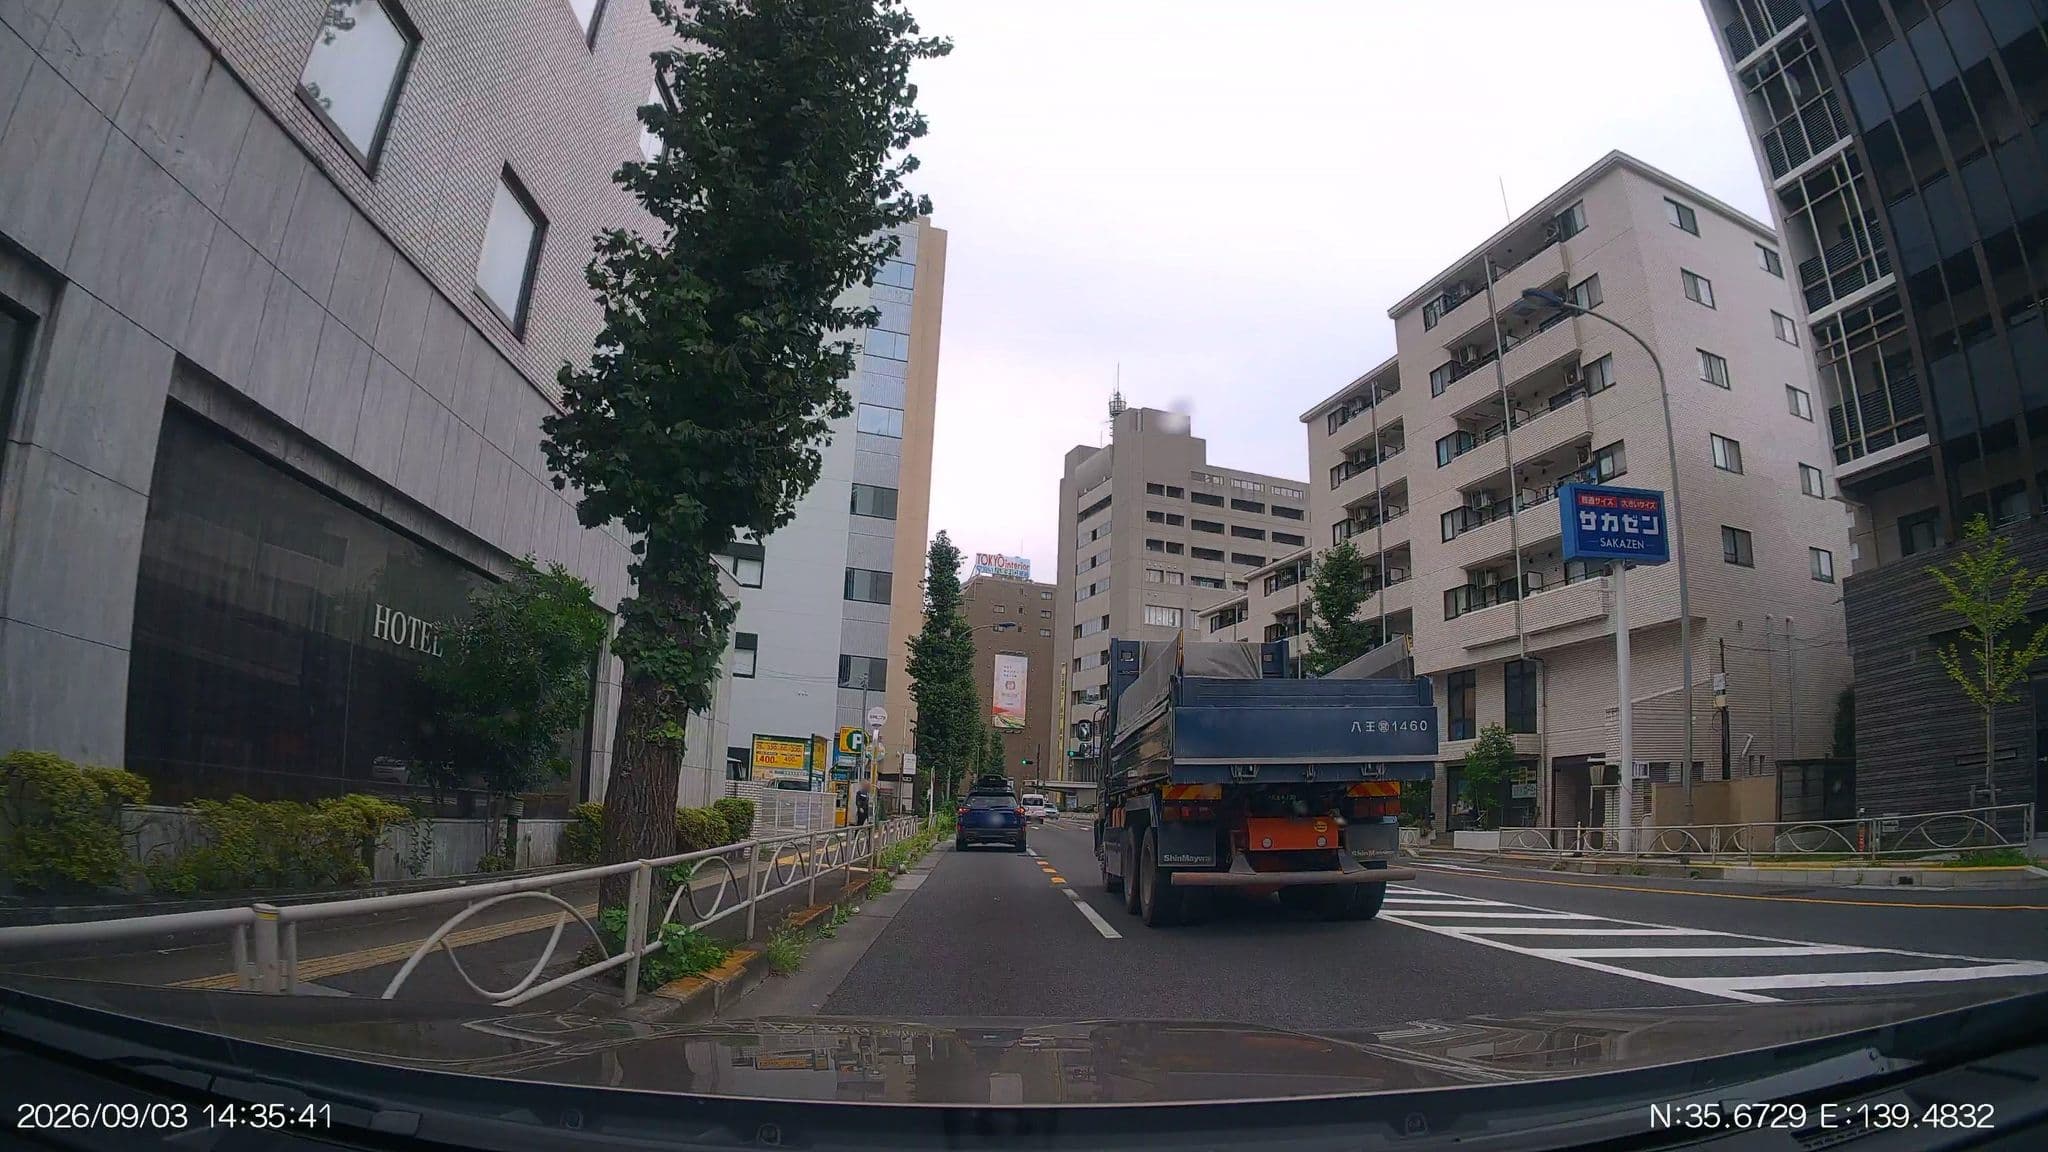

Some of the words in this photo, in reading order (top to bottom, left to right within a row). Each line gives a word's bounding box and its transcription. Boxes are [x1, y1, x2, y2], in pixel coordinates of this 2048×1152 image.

[1579, 510, 1659, 535] サカゼン
[1600, 537, 1645, 549] SAKAZEN
[372, 603, 443, 658] HOTEL
[852, 733, 862, 749] P
